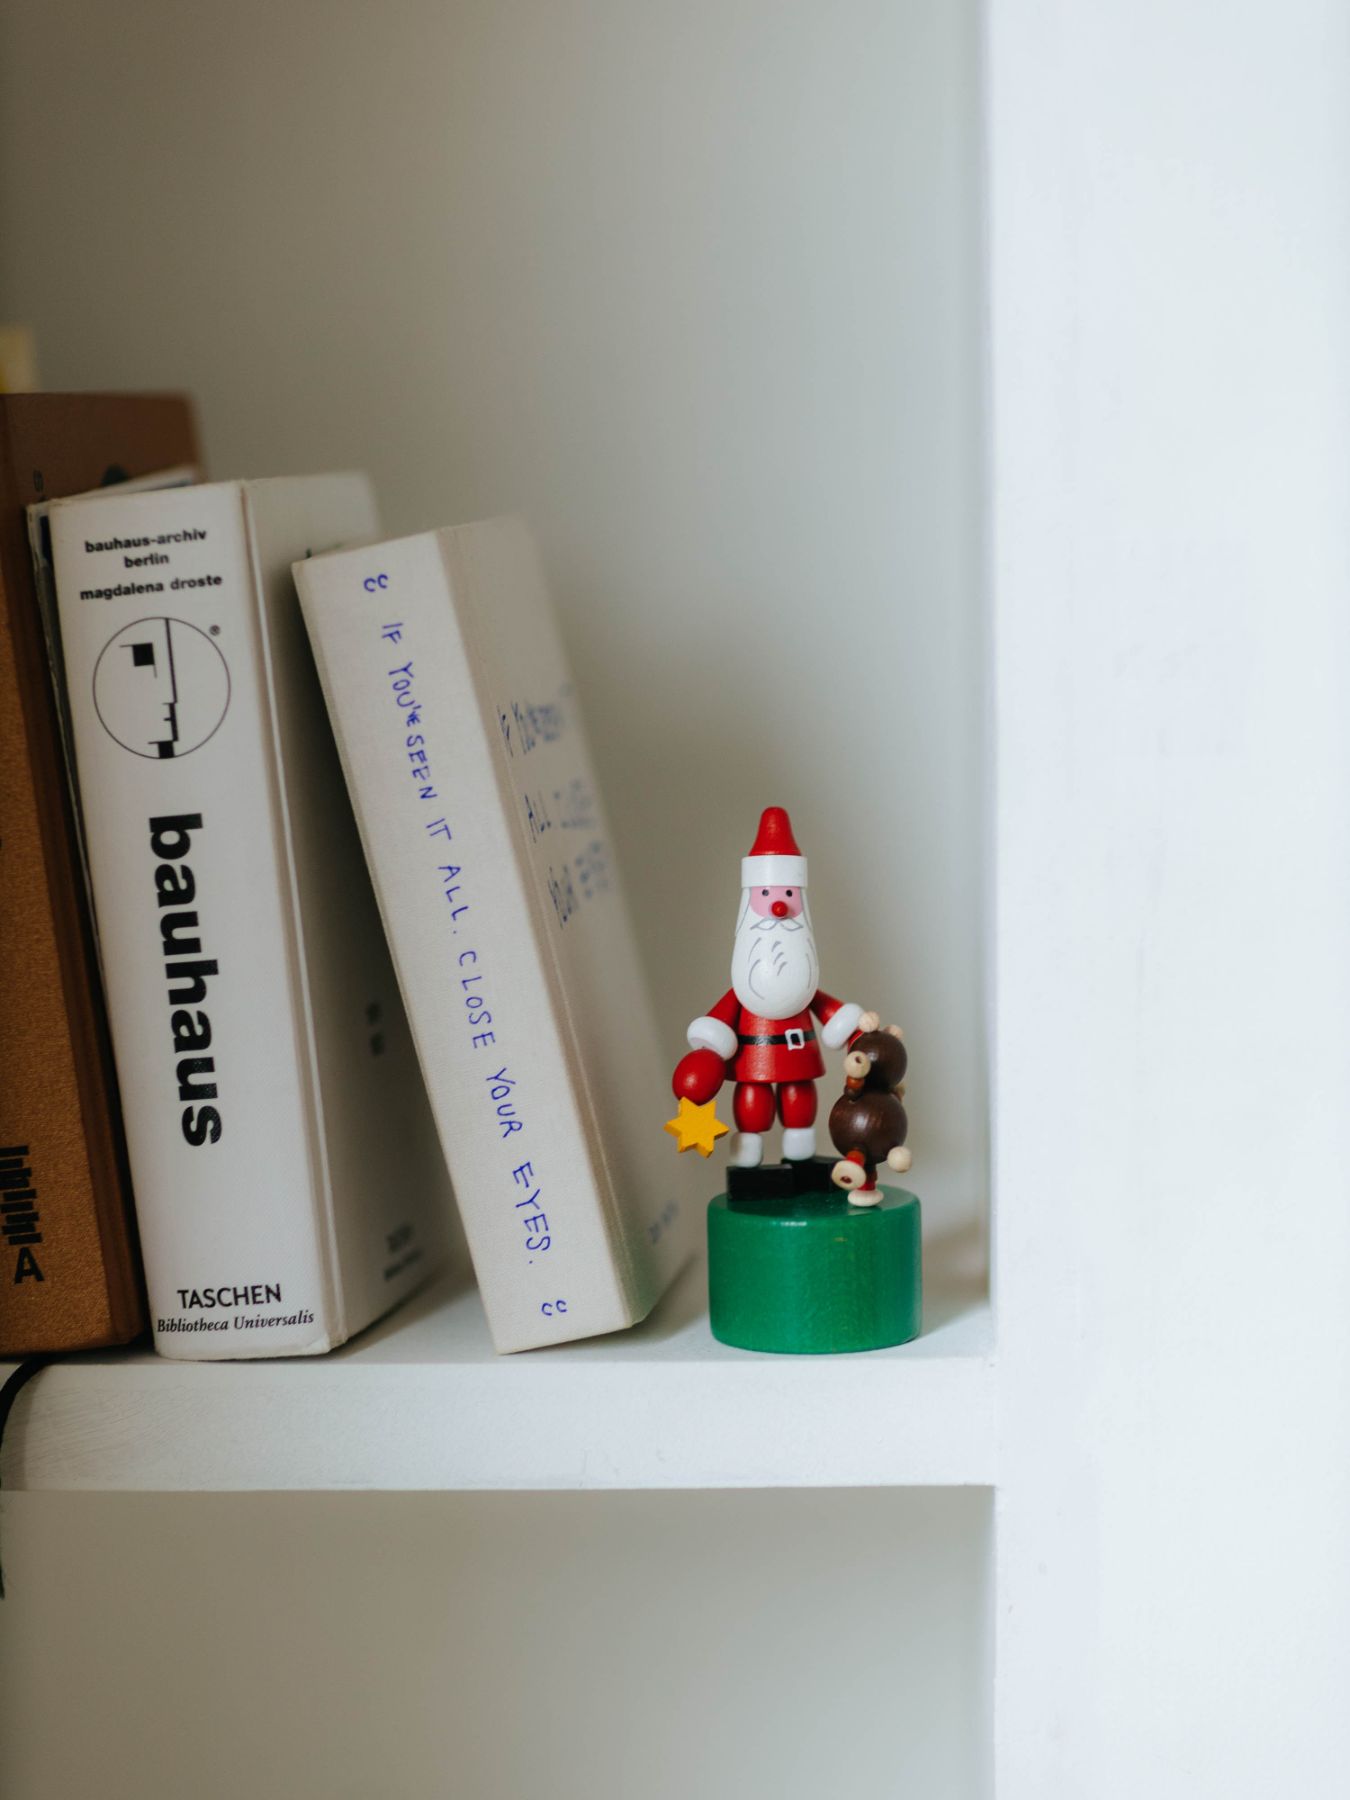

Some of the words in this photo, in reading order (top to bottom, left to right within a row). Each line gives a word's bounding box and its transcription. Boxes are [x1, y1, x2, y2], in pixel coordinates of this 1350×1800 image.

[84, 528, 207, 553] bauhaus-archiv
[123, 552, 170, 569] berlin
[79, 581, 165, 601] magdalena
[170, 574, 223, 591] droste
[381, 622, 404, 645] IF
[405, 734, 438, 800] SEEN
[425, 817, 452, 840] IT
[458, 950, 497, 1050] CLOSE
[486, 1067, 525, 1139] YOUR
[149, 813, 222, 1147] bauhaus
[176, 1283, 283, 1310] TASCHEN
[156, 1317, 230, 1333] Bibliotheca
[233, 1310, 315, 1330] Universalis
